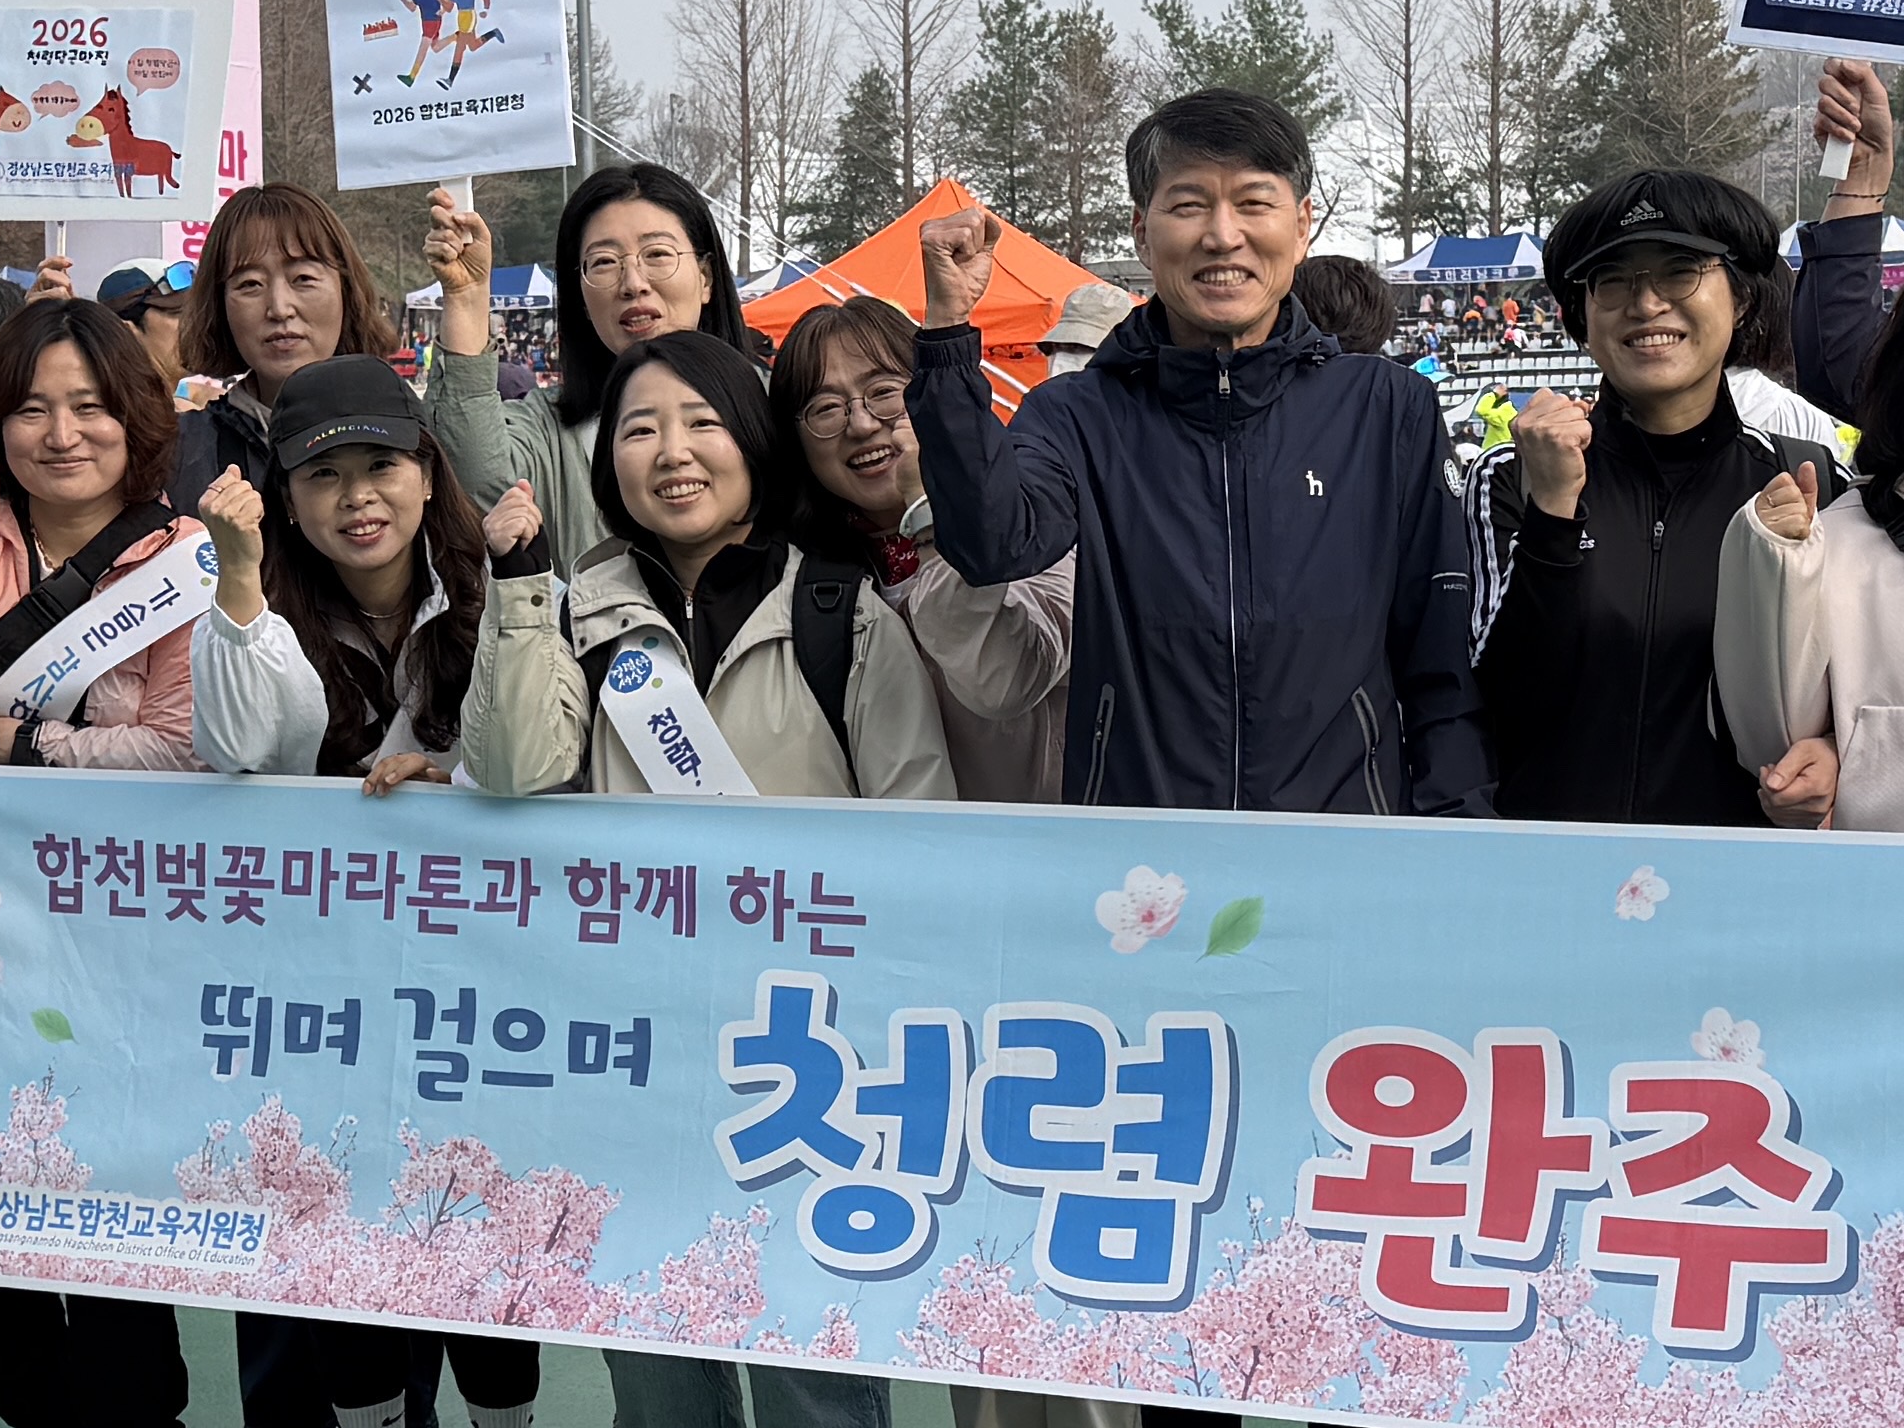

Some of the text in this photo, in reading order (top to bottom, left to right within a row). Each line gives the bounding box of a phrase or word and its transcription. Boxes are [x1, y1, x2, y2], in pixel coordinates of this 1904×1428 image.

[32, 17, 109, 47] 2026
[372, 93, 525, 125] 2026 합천교육지원청
[1620, 210, 1664, 227] adidas
[32, 832, 867, 959] 합천벚꽃마라톤과 함께 하는
[200, 970, 1858, 1356] 뛰며 걸으며 청렴 완주
[64, 1237, 114, 1253] Hapcheon
[117, 1242, 153, 1257] District
[154, 1244, 186, 1260] Office
[203, 1250, 256, 1266] Education
